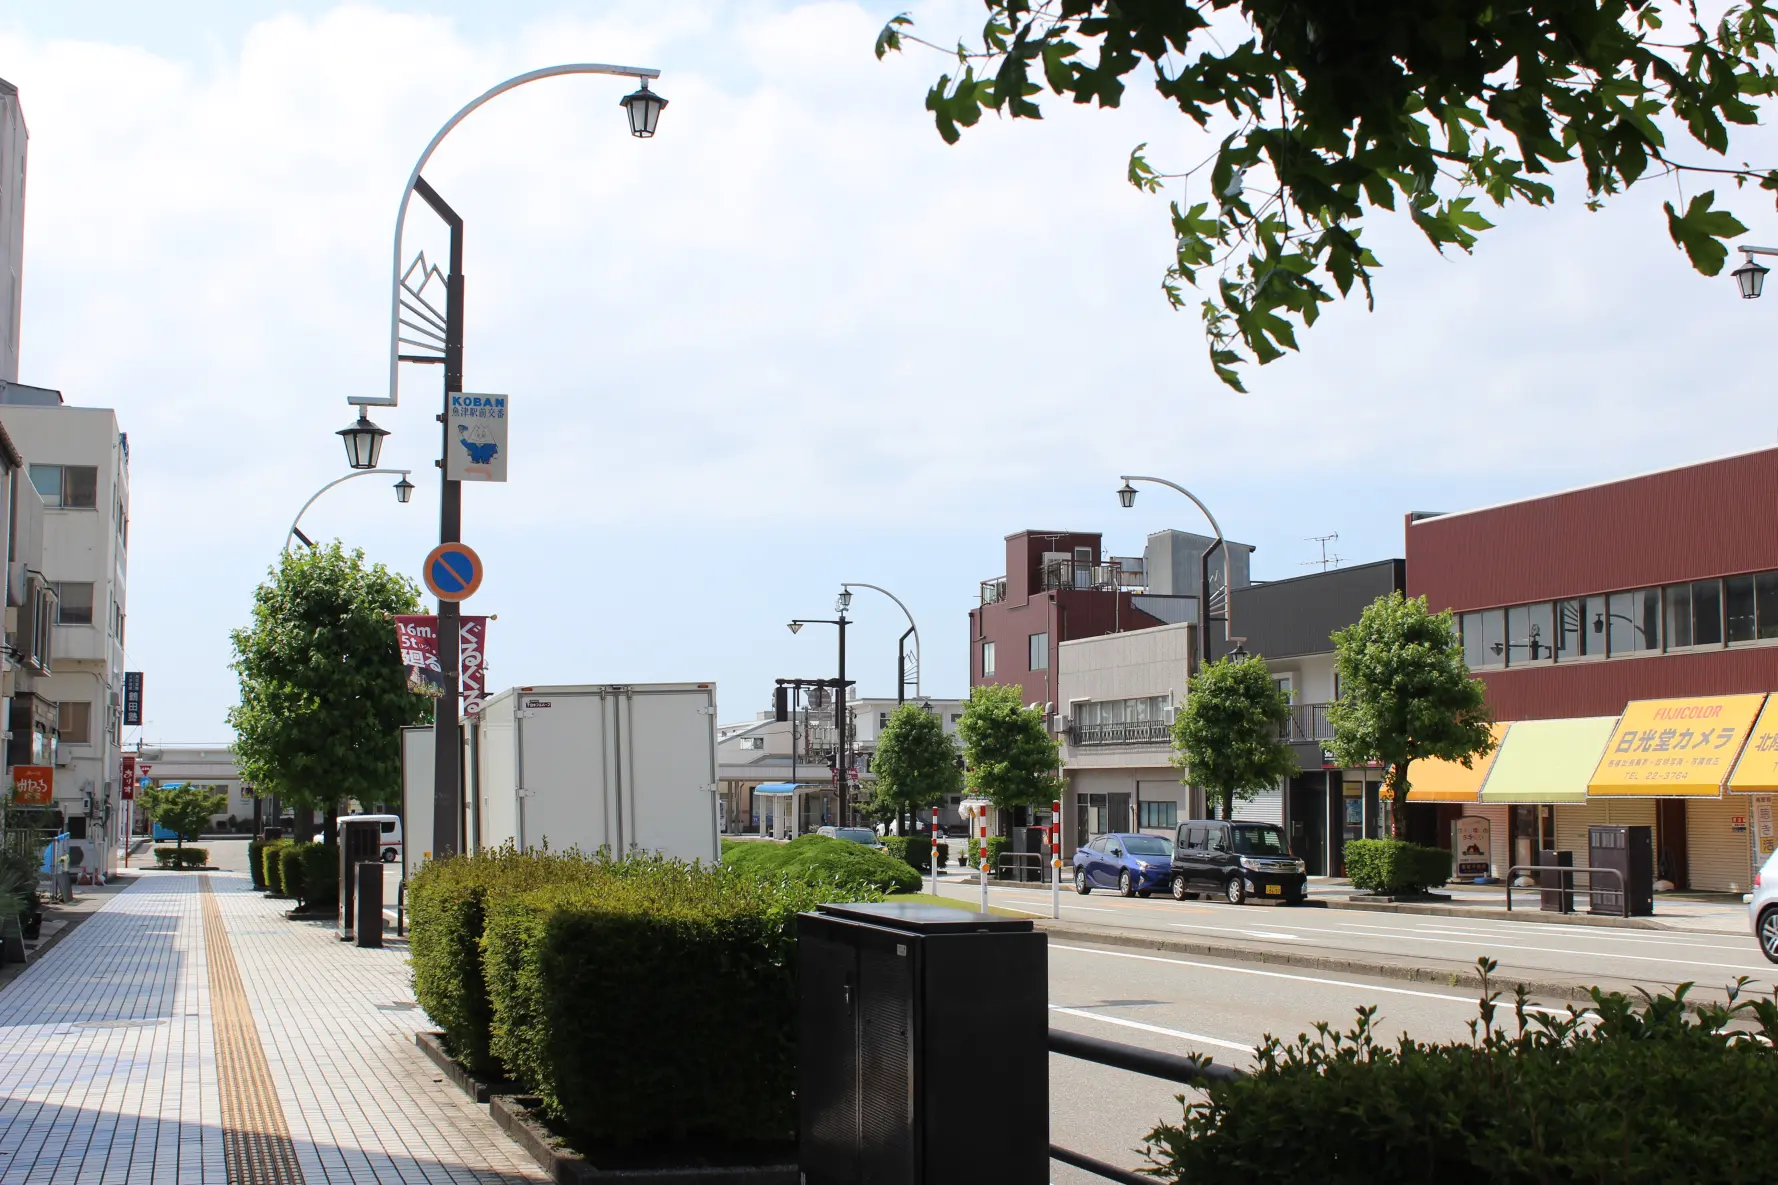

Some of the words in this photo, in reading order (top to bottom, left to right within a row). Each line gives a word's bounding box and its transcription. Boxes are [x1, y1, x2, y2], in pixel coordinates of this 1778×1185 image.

[452, 396, 505, 408] KOBAN
[451, 406, 505, 419] 魚津駅前交番
[460, 621, 484, 713] ぐるぐる
[1653, 704, 1724, 721] FUJICOLOR
[1614, 727, 1736, 754] 日光堂カメラ
[1624, 771, 1640, 780] TEL
[1645, 771, 1689, 780] 22-3764
